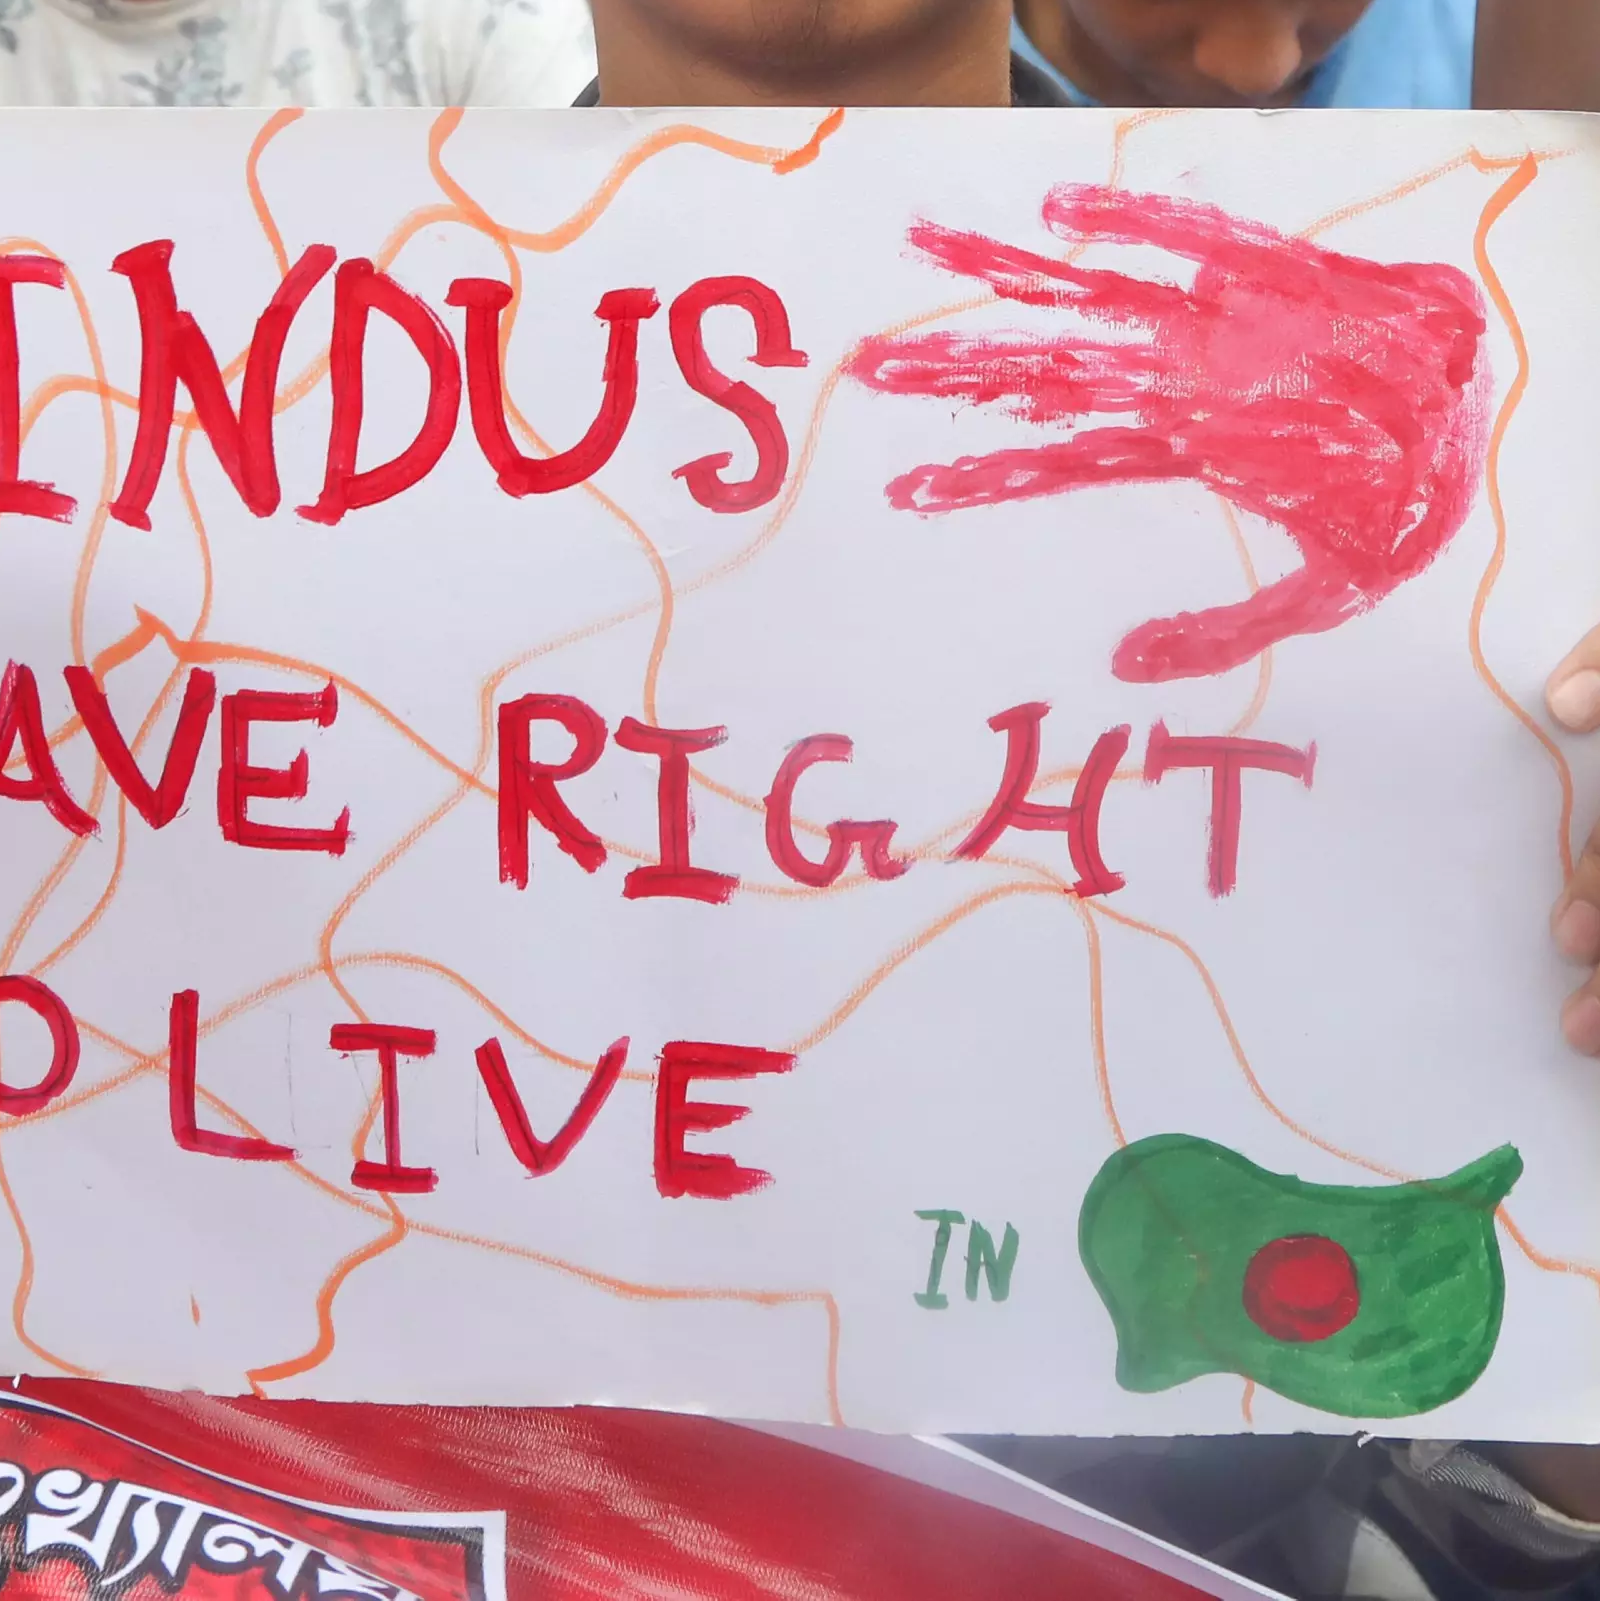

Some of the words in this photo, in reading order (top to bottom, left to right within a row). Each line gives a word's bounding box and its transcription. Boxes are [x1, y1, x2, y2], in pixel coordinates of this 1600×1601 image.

[496, 692, 1317, 905] RIGHT
[168, 987, 799, 1200] LIVE
[913, 1208, 1020, 1311] IN
